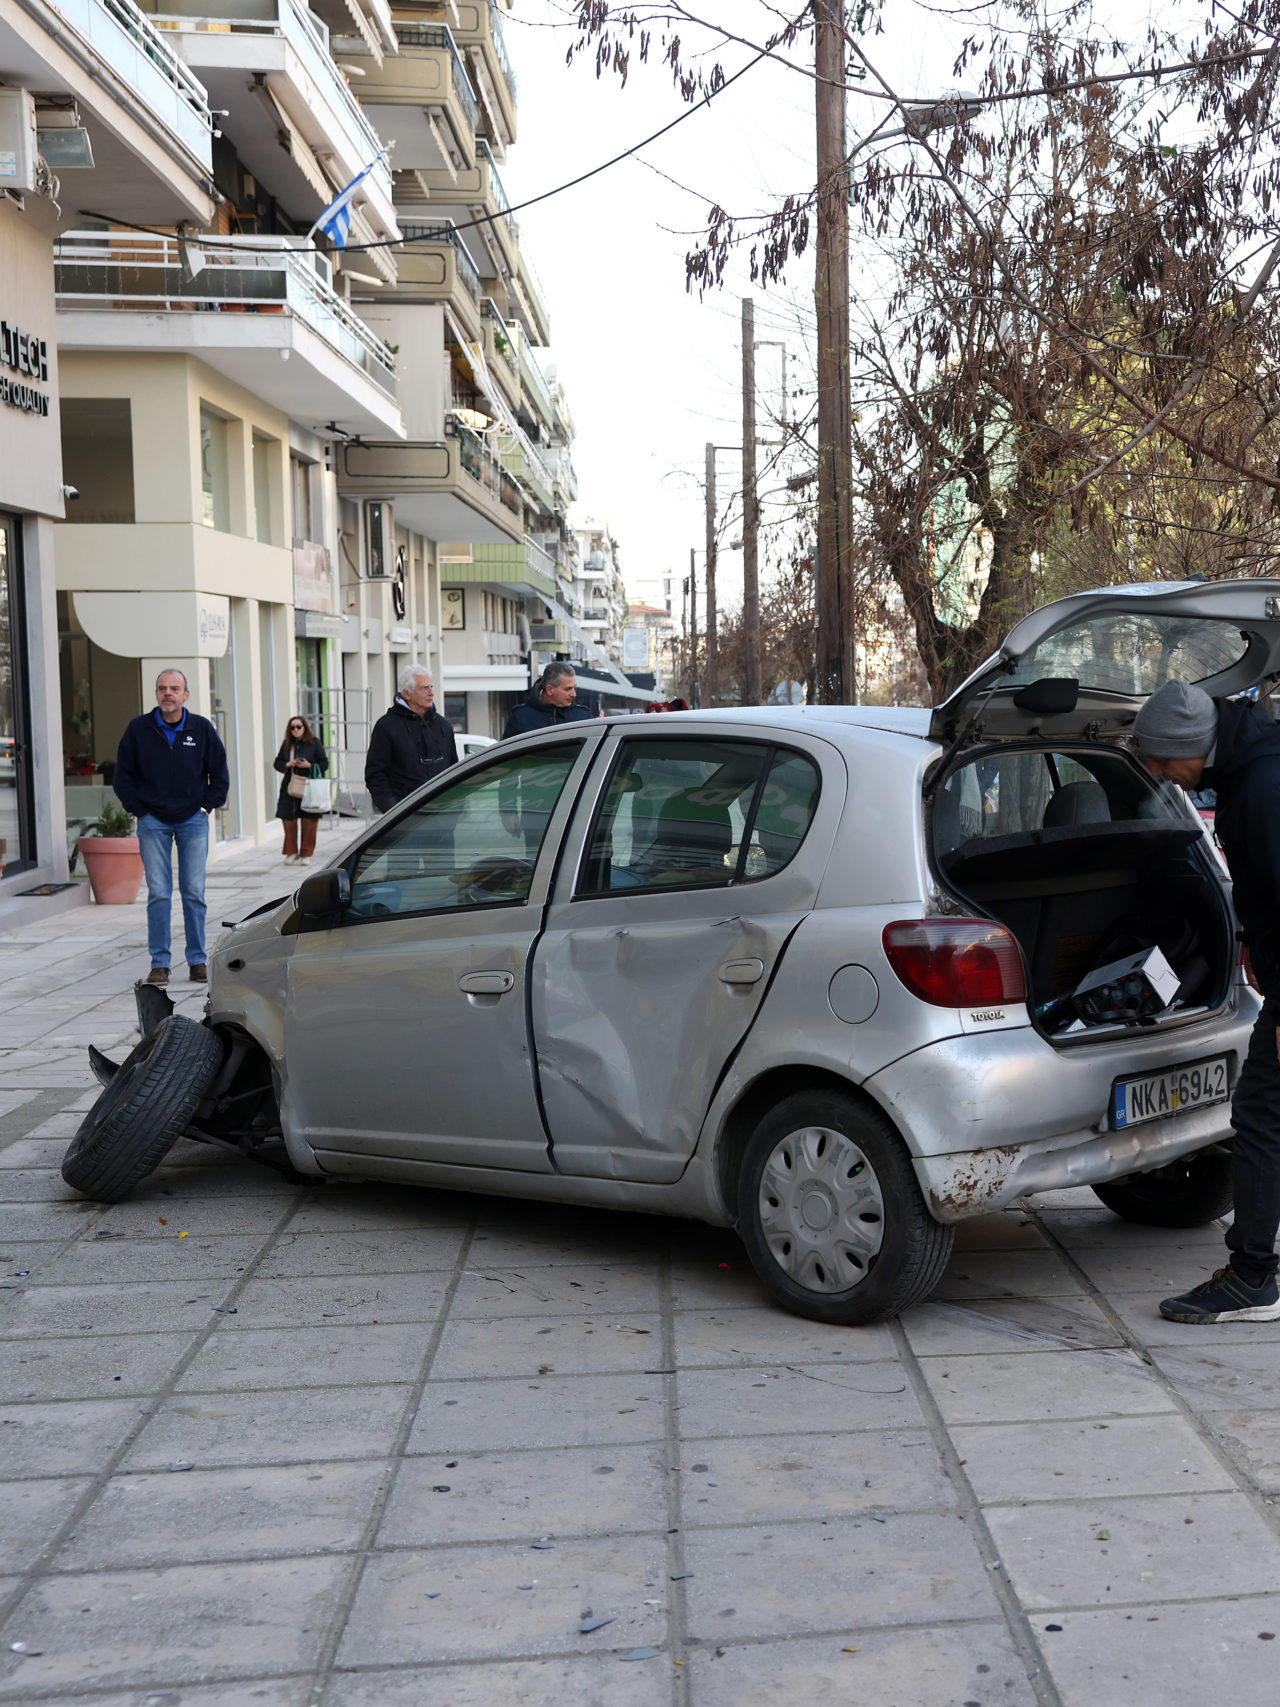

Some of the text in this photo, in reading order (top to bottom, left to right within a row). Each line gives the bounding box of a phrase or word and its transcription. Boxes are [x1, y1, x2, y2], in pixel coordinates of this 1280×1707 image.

[13, 383, 50, 417] QUALITY
[971, 1010, 1006, 1022] TOYOTA
[1115, 1110, 1126, 1119] GR
